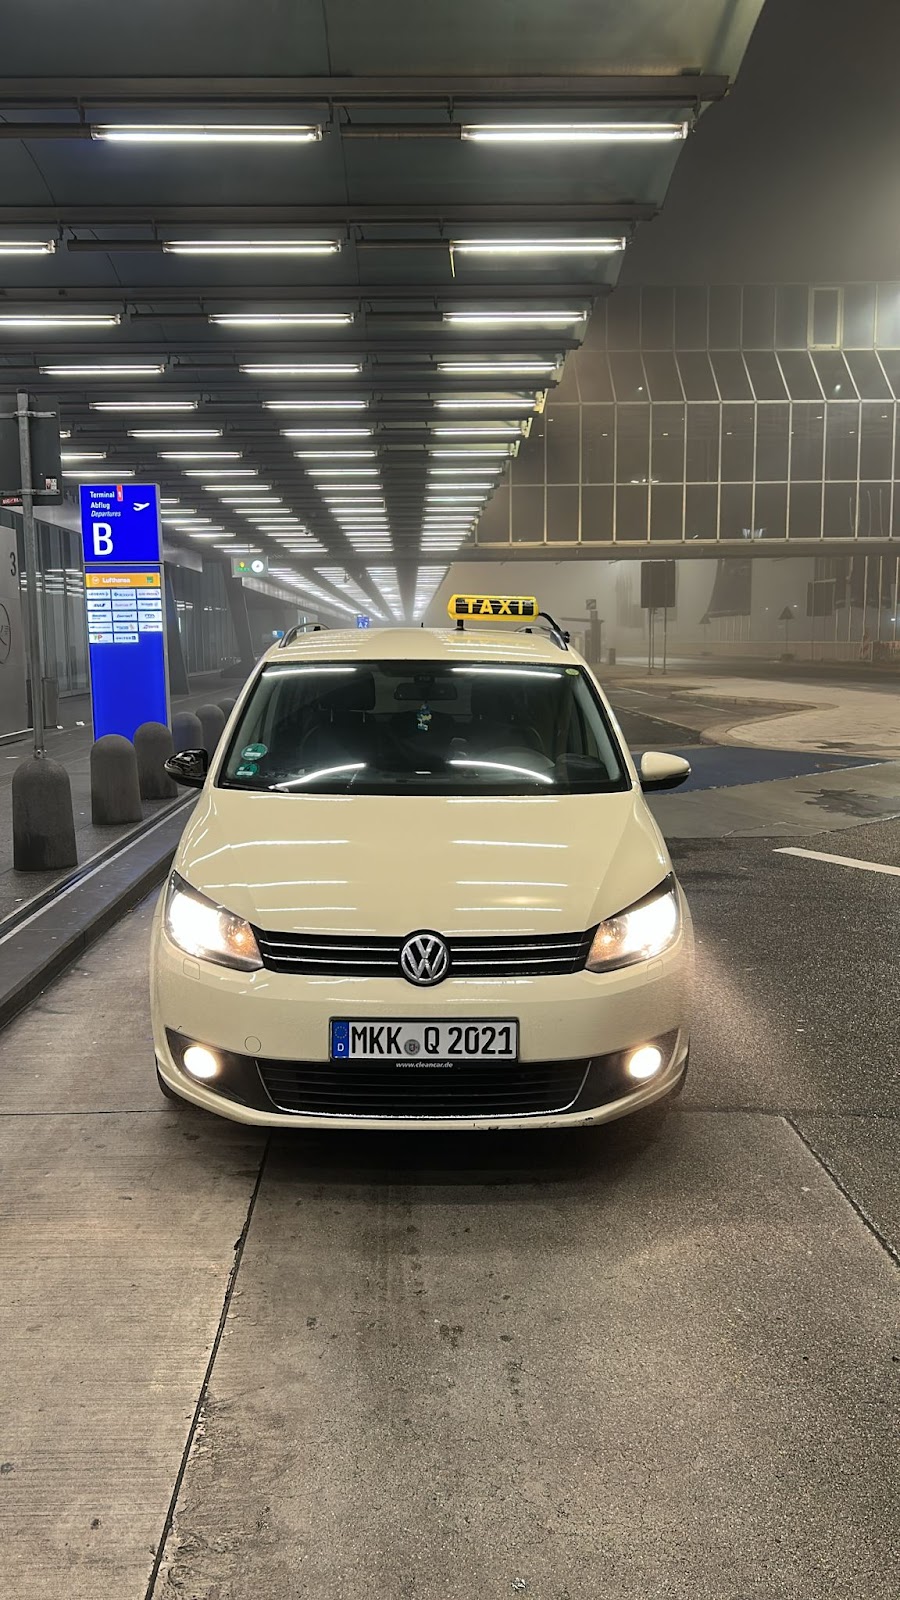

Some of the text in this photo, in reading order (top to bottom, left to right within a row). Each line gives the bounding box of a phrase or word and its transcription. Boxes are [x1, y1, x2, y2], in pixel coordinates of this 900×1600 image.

[93, 522, 113, 555] B
[10, 552, 16, 576] 3
[464, 599, 524, 615] TAXI
[337, 1043, 344, 1051] D
[352, 1026, 513, 1054] MKK Q 2021
